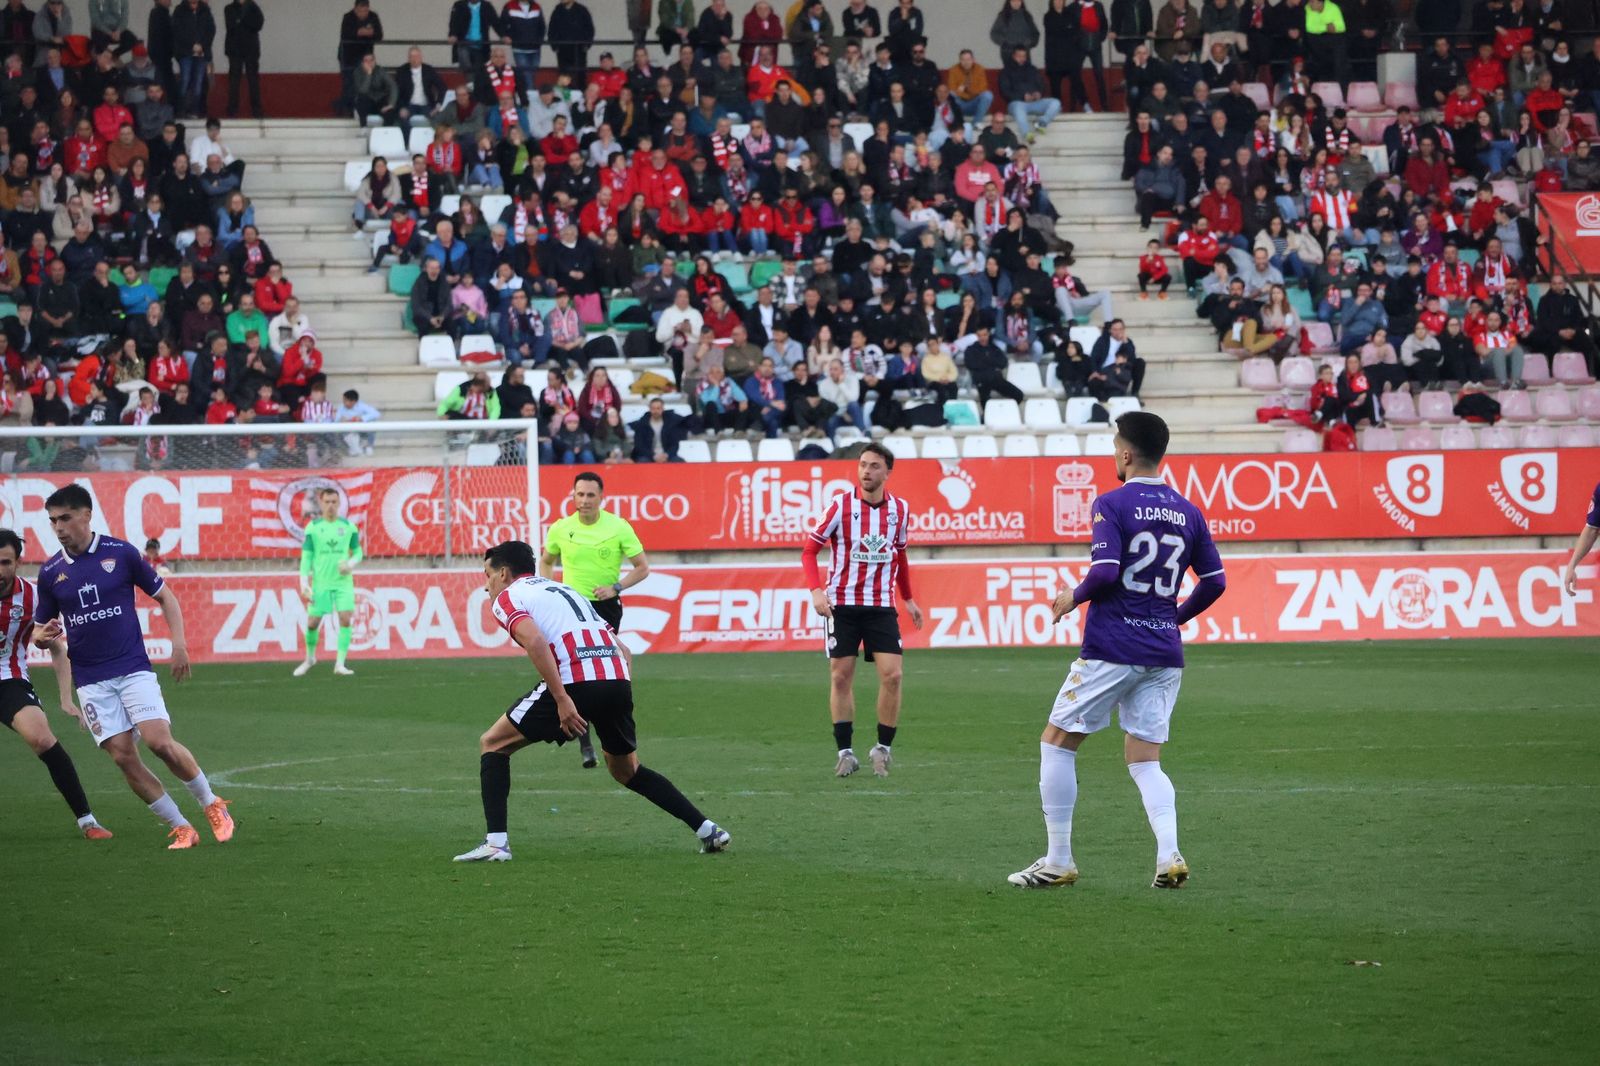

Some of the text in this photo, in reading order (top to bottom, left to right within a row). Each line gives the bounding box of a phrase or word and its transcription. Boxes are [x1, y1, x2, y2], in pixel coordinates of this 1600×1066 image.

[1161, 460, 1338, 512] AMORA
[1407, 463, 1430, 504] 8
[1520, 461, 1545, 502] 8
[560, 489, 690, 522] ÓTICO
[1135, 507, 1187, 527] J.CASADO
[1373, 483, 1416, 533] ZAMORA
[1487, 481, 1530, 531] ZAMORA
[1121, 531, 1186, 598] 23
[67, 605, 123, 627] Hercesa
[679, 589, 826, 630] FRIM
[1276, 566, 1516, 632] ZAMORA
[1517, 565, 1594, 628] CF
